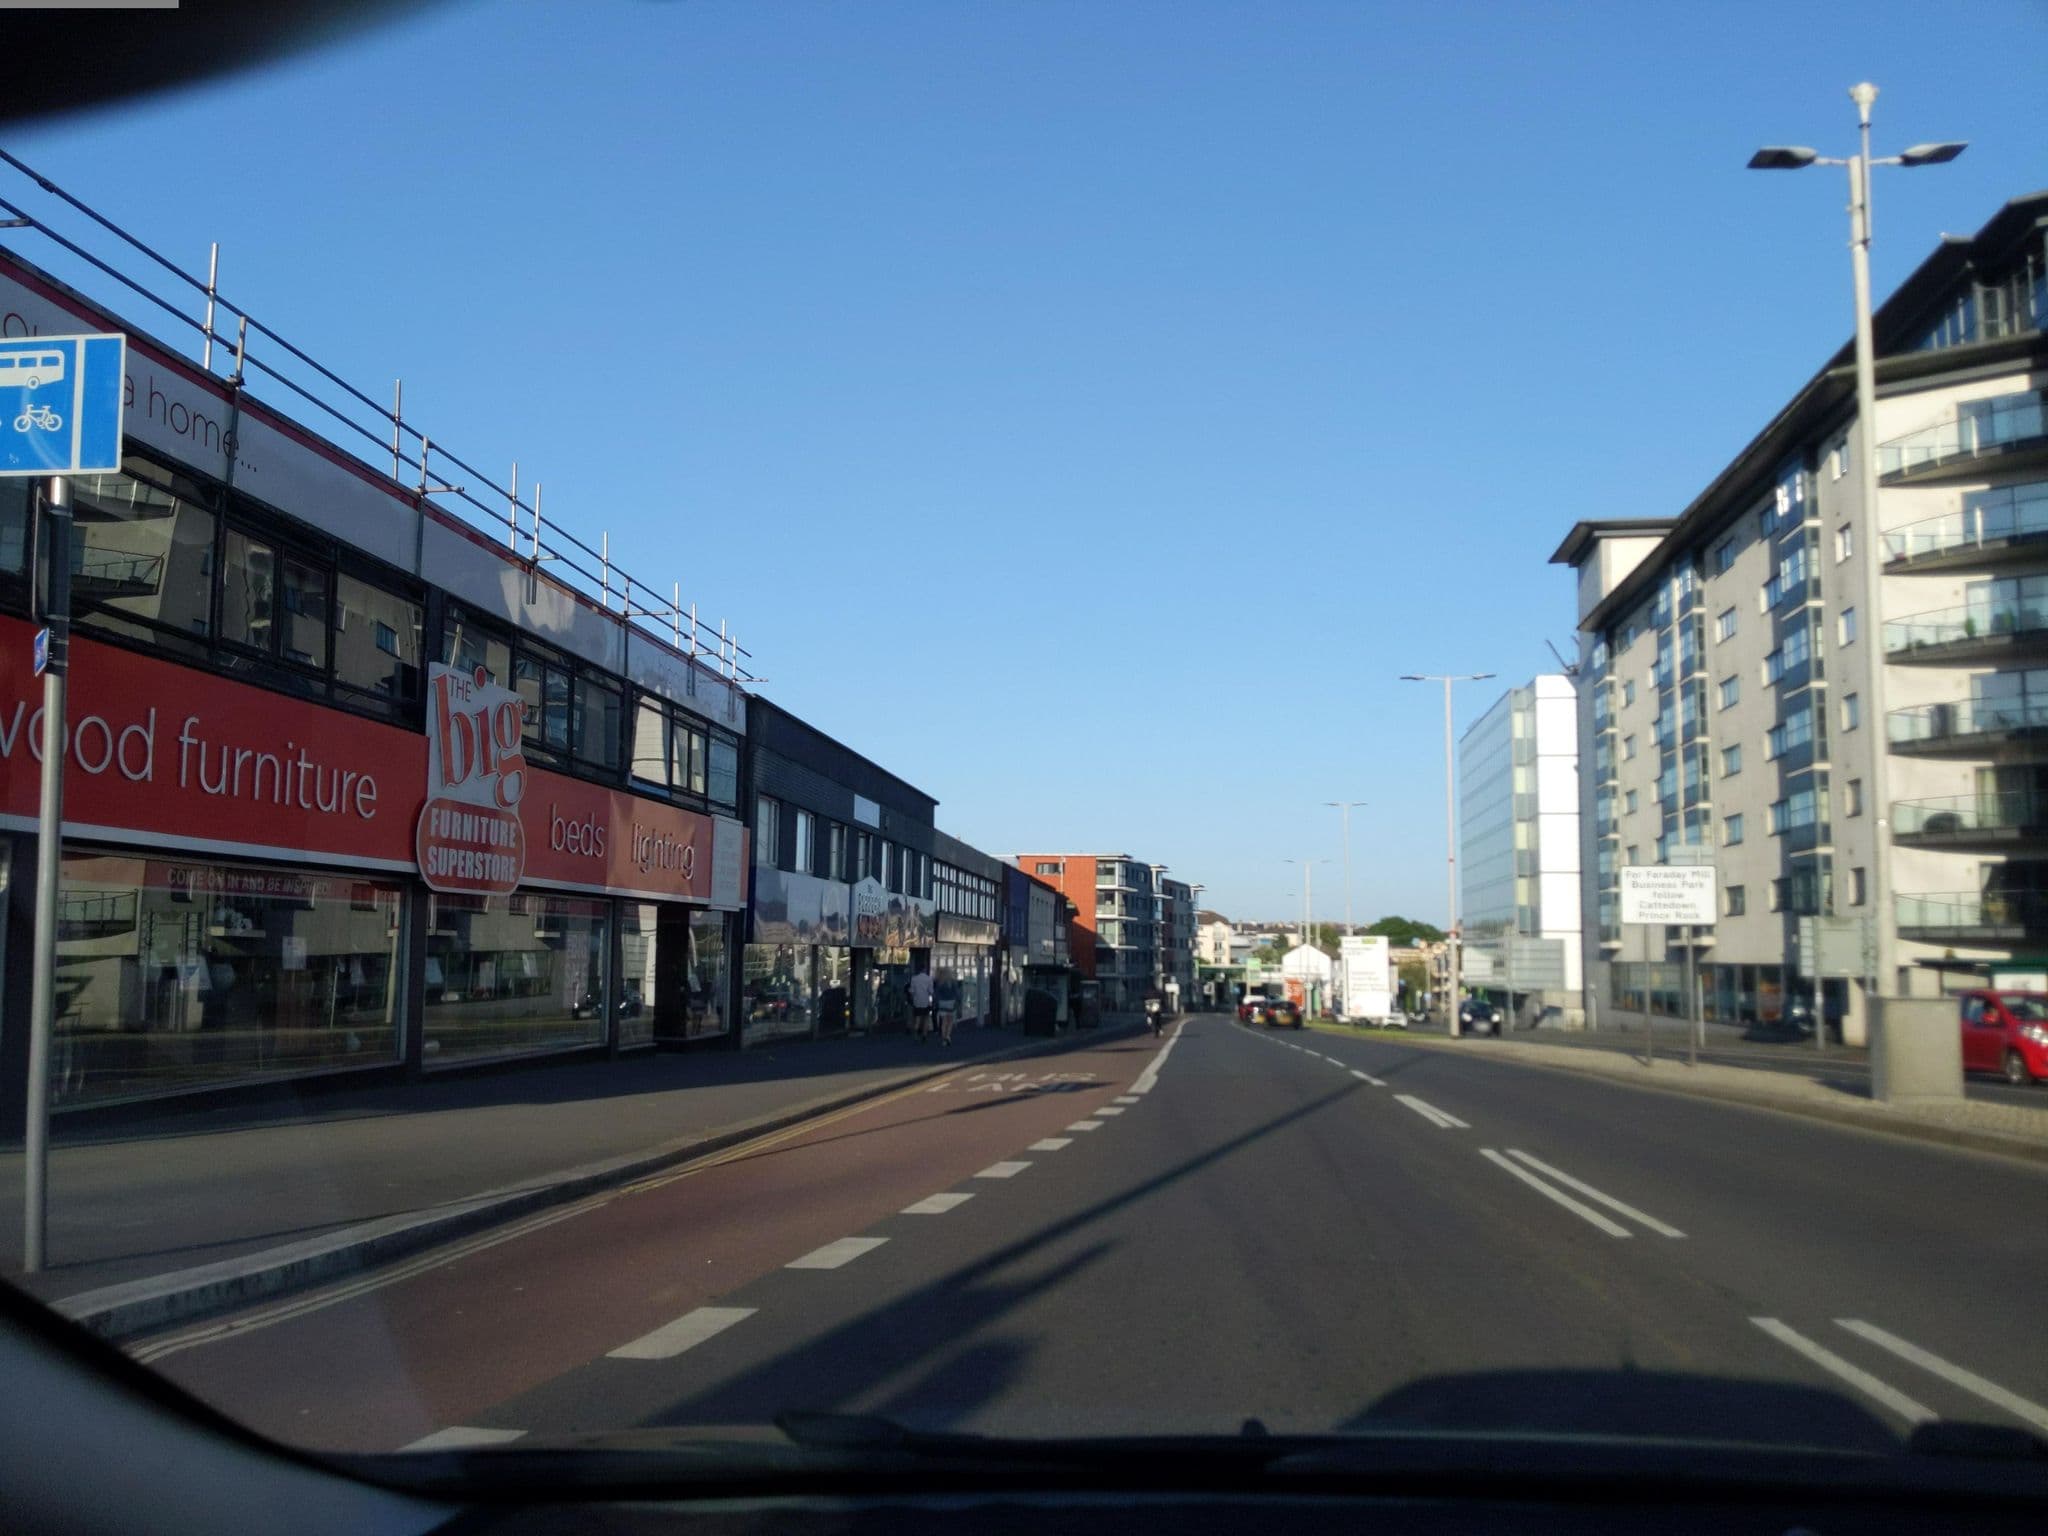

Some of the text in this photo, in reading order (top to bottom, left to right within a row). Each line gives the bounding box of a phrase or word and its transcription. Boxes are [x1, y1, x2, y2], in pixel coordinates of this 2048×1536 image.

[449, 674, 472, 702] THE
[432, 665, 529, 810] big
[178, 716, 378, 819] furniture
[430, 807, 517, 849] FURNITURE
[550, 801, 605, 858] beds
[427, 846, 517, 883] SUPERSTORE
[630, 821, 696, 880] lighting
[167, 868, 205, 887] COME
[227, 873, 240, 889] IN
[242, 874, 264, 890] AND
[266, 876, 280, 891] BE
[1625, 870, 1711, 880] For Faraday Mill
[1631, 881, 1704, 889] Business Park
[1652, 891, 1684, 899] follow
[1638, 911, 1669, 919] Prince
